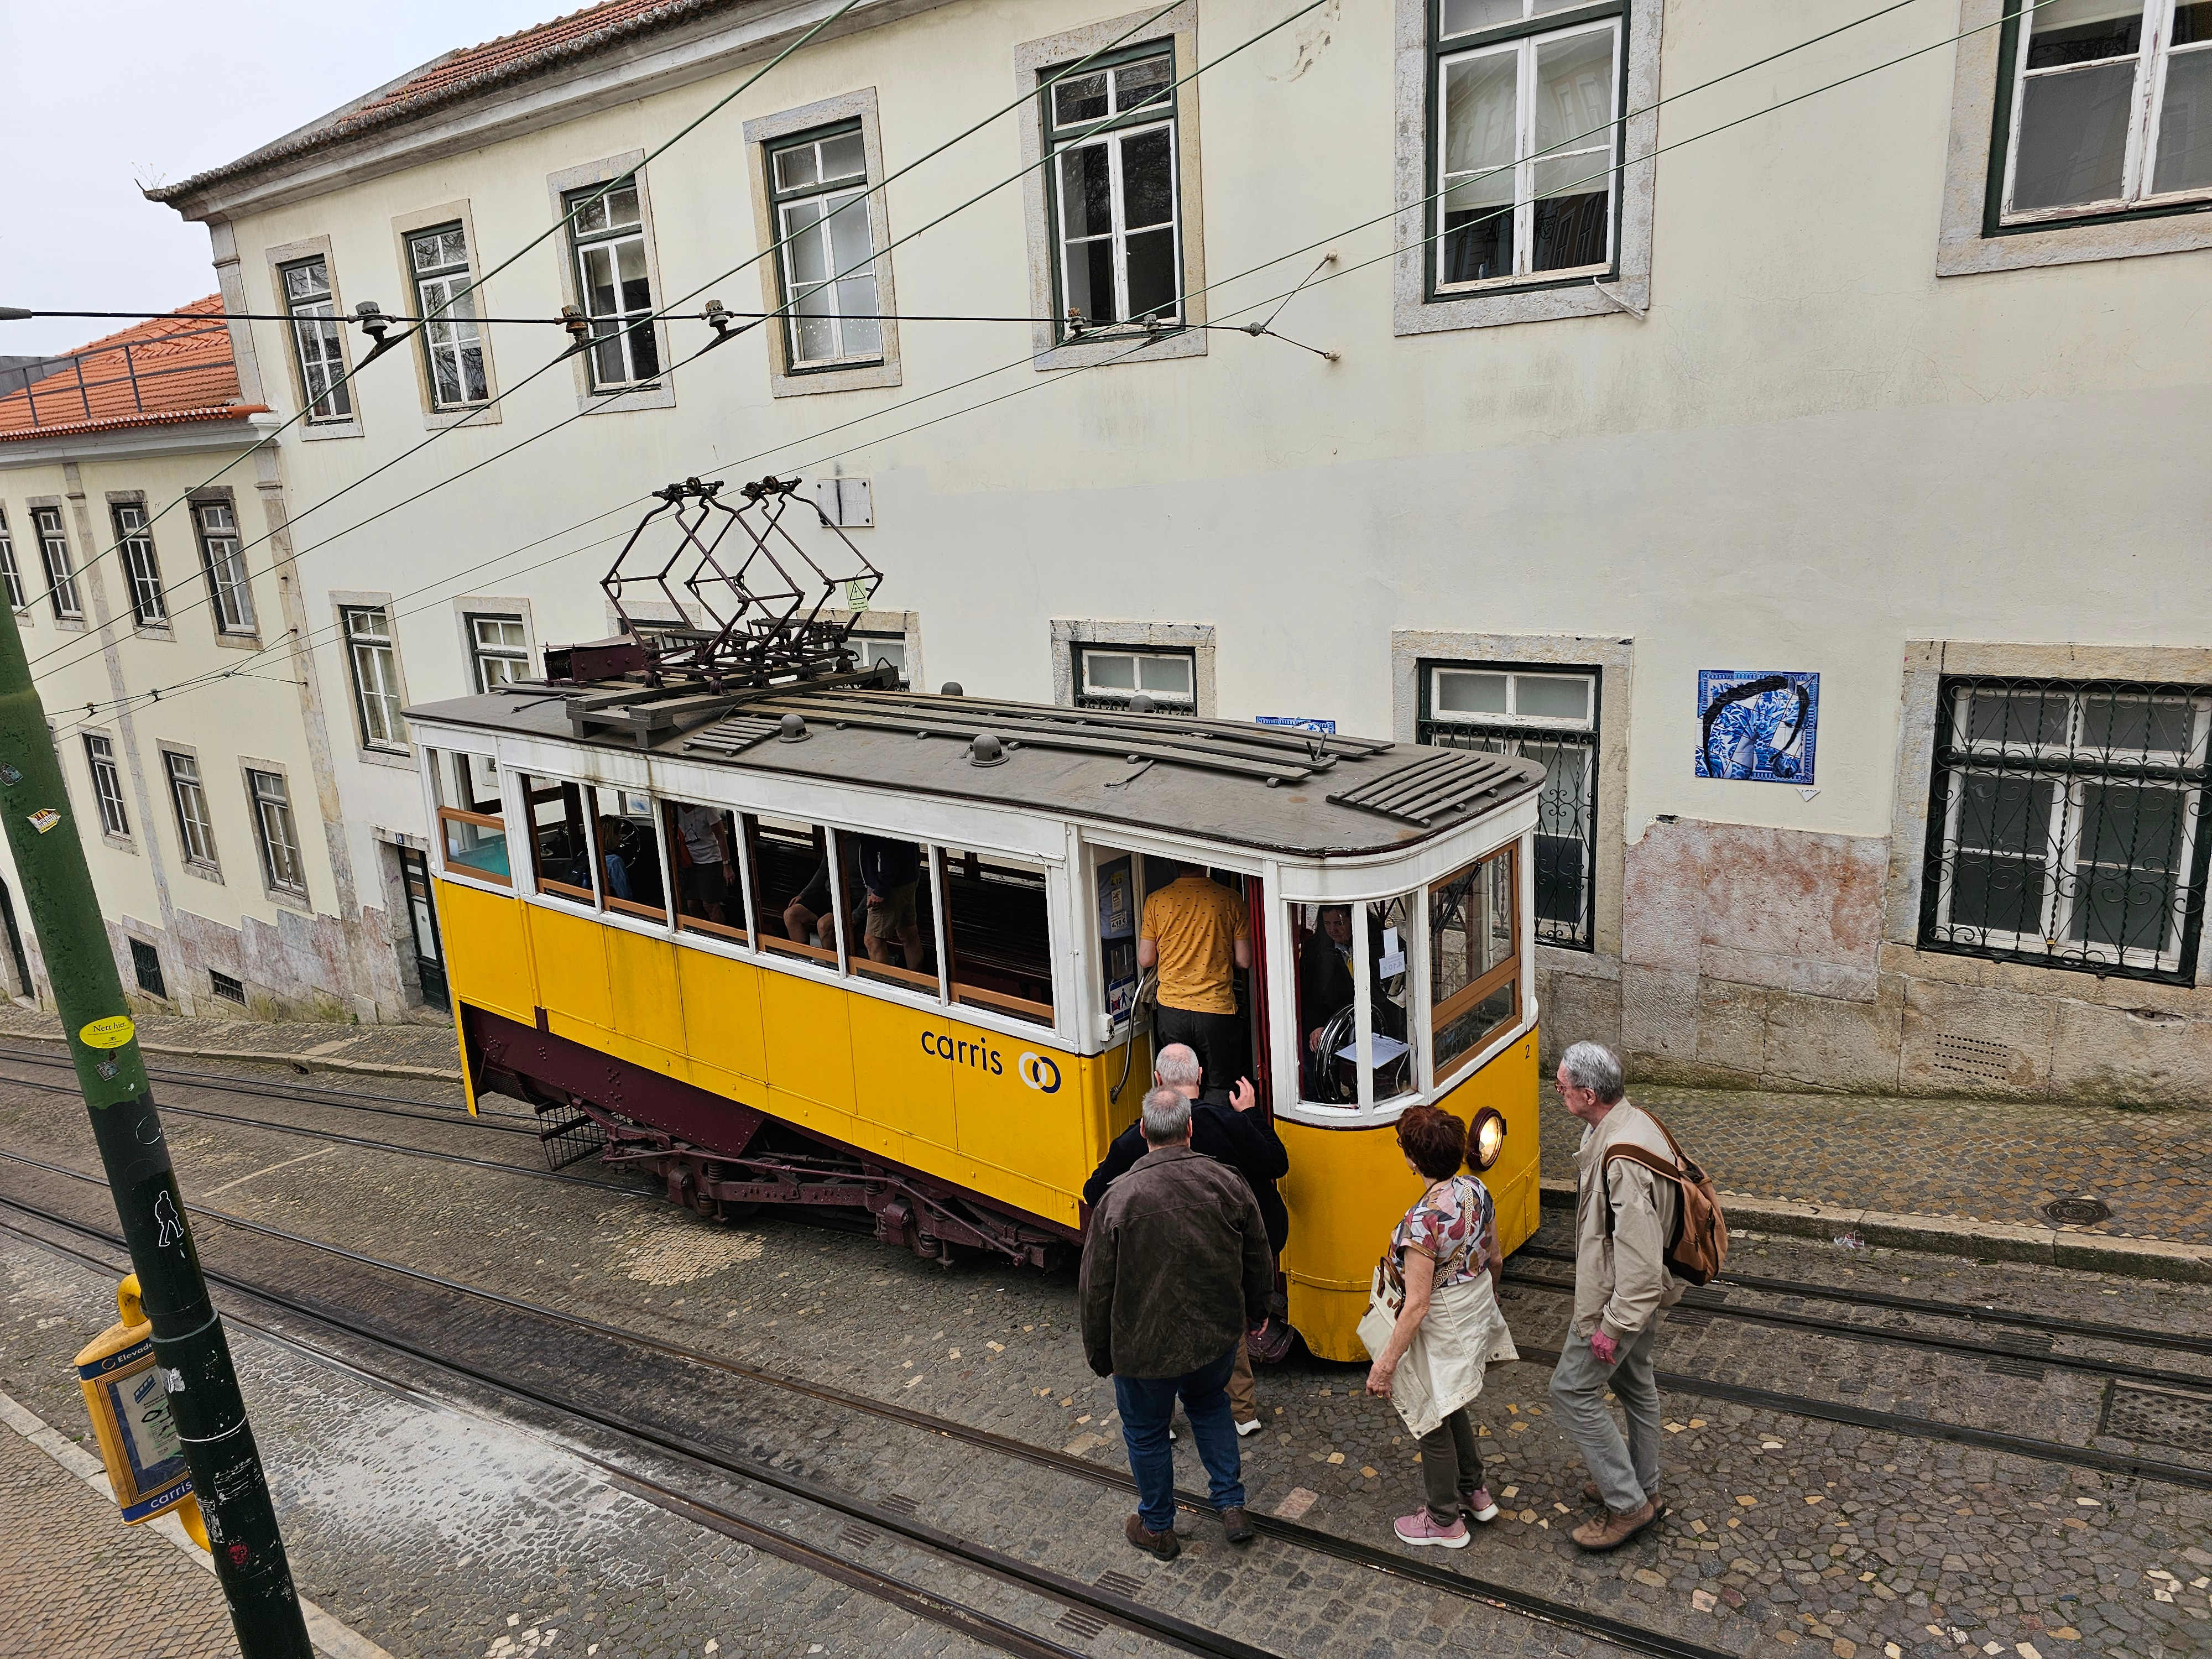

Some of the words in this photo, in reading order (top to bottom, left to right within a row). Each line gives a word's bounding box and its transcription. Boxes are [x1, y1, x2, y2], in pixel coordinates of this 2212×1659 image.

[921, 1031, 1003, 1076] carris
[1525, 1044, 1530, 1060] 2
[150, 1481, 192, 1508] carris
